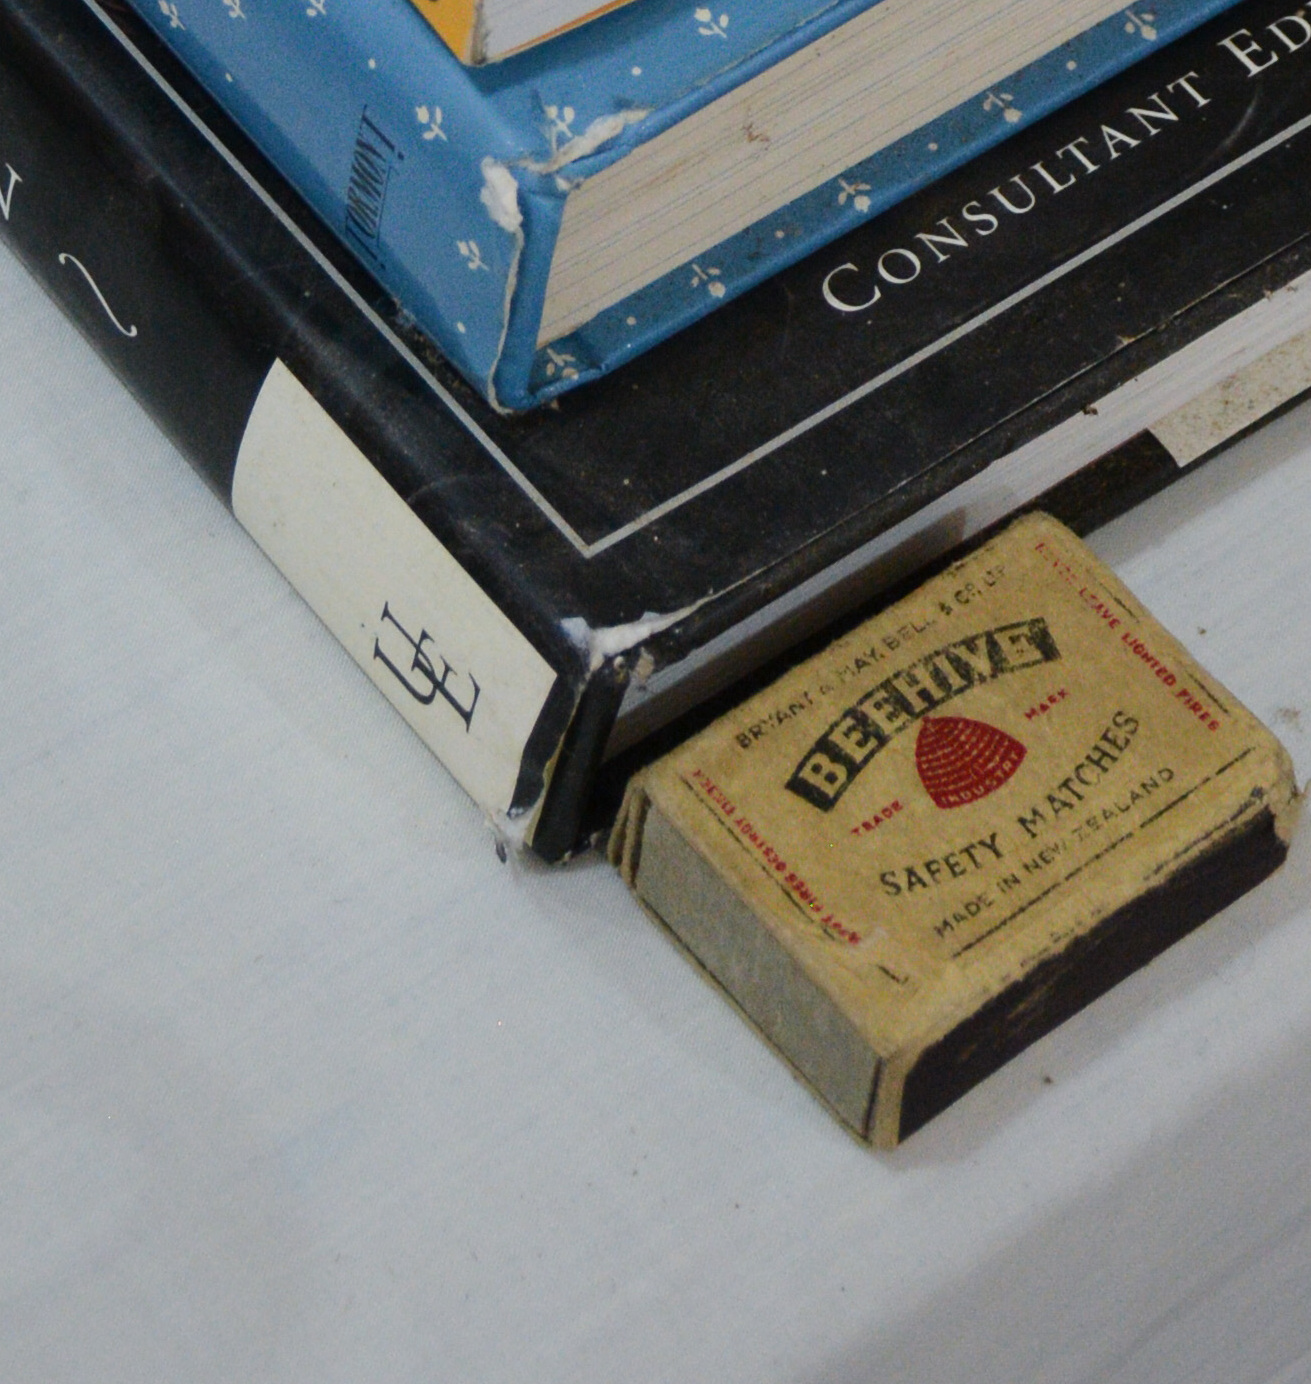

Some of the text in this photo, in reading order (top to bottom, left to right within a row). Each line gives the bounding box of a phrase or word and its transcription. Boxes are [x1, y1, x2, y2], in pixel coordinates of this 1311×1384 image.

[821, 70, 1211, 313] CONSULTANT
[1120, 631, 1177, 687] LIGHTED
[797, 622, 1054, 806] BEEHIVE
[879, 710, 1140, 897] SAFETY MATCHES
[940, 751, 1019, 805] INDUSTRY
[850, 799, 904, 837] TRADE
[933, 893, 994, 938] MADE
[995, 872, 1022, 895] IN
